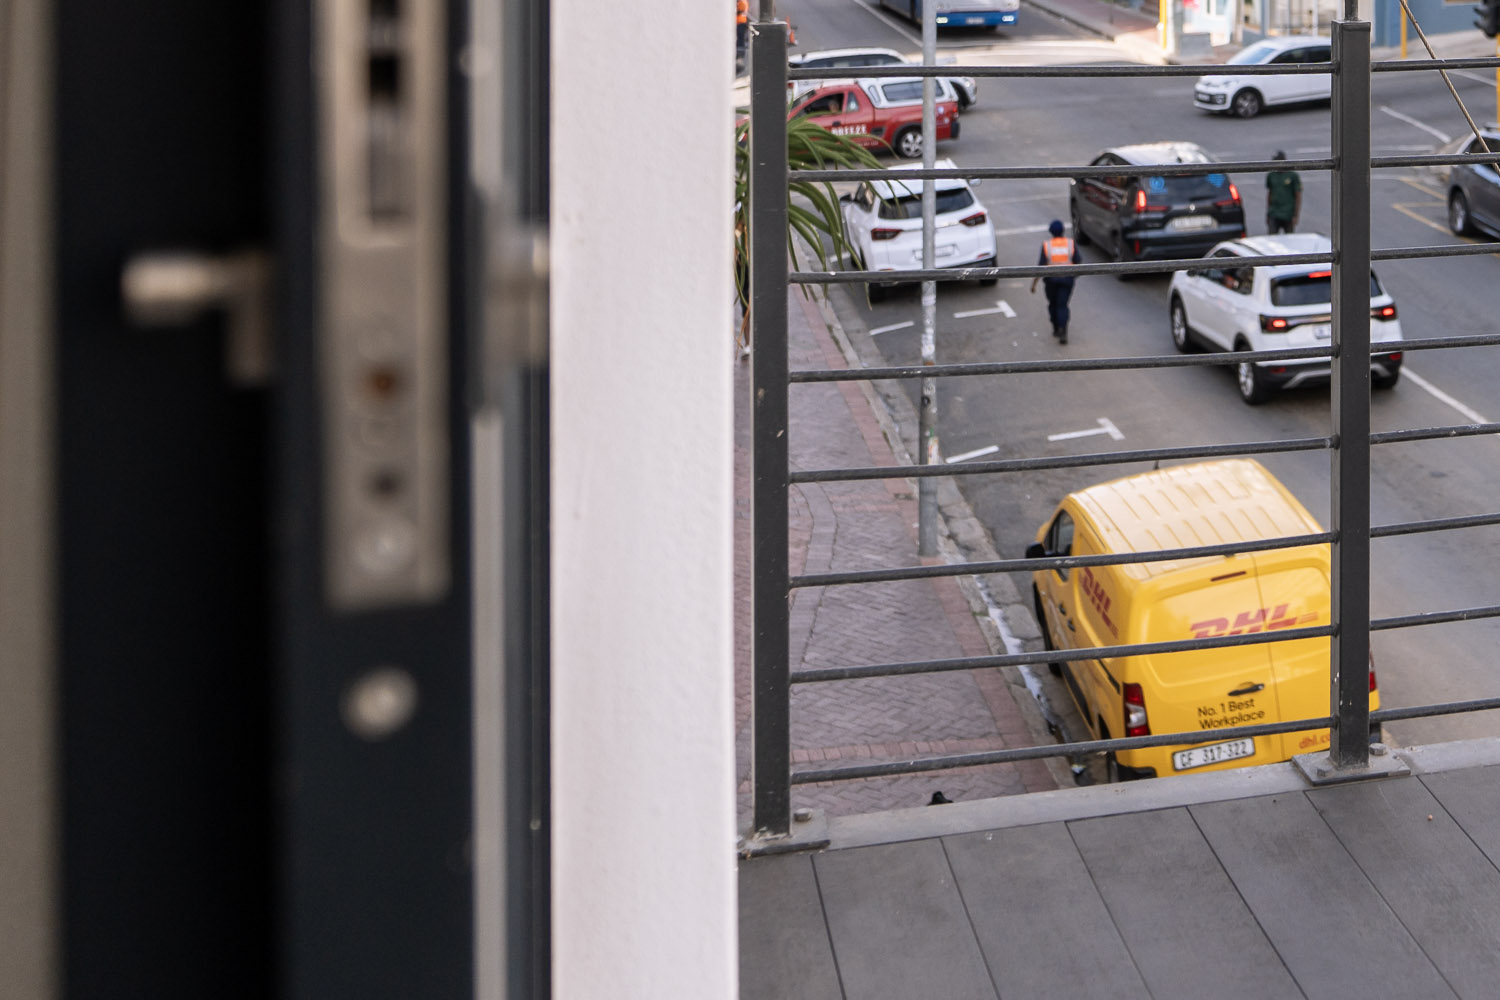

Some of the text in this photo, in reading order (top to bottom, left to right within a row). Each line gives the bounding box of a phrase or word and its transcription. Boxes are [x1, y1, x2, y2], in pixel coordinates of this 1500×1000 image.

[1081, 566, 1113, 630] DHL
[1190, 602, 1299, 638] DHL
[1197, 698, 1255, 717] No. 1 Best
[1199, 709, 1266, 730] Workplace
[1299, 733, 1330, 750] dhl.co
